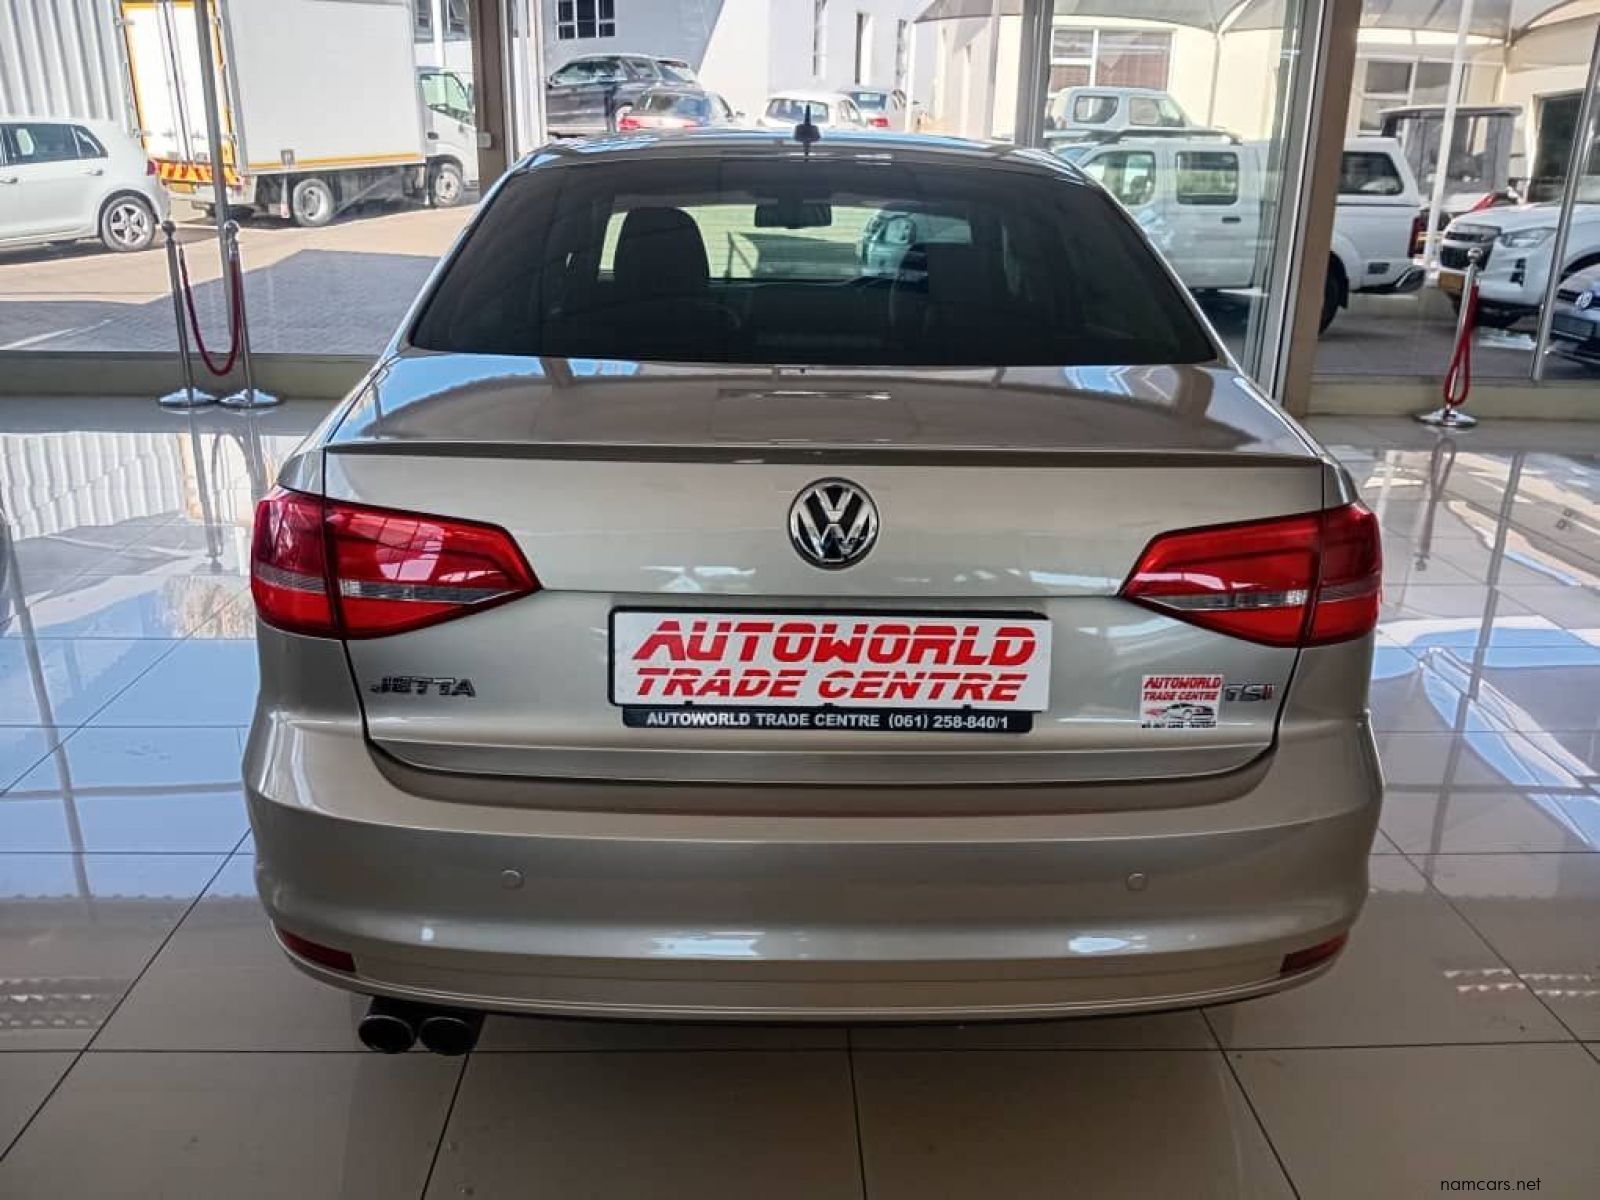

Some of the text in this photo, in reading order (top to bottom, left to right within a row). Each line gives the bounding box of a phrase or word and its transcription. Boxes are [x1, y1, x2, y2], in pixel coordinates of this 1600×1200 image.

[633, 620, 1036, 666] AUTOWORLD
[369, 675, 476, 698] JETTA
[637, 667, 1028, 701] TRADE CENTRE
[1144, 677, 1221, 689] AUTOWORLD
[1144, 691, 1219, 701] TRADE CENTRE
[647, 712, 1008, 729] AUTOWORLD TRADE CENTRE (061) 258-840/1
